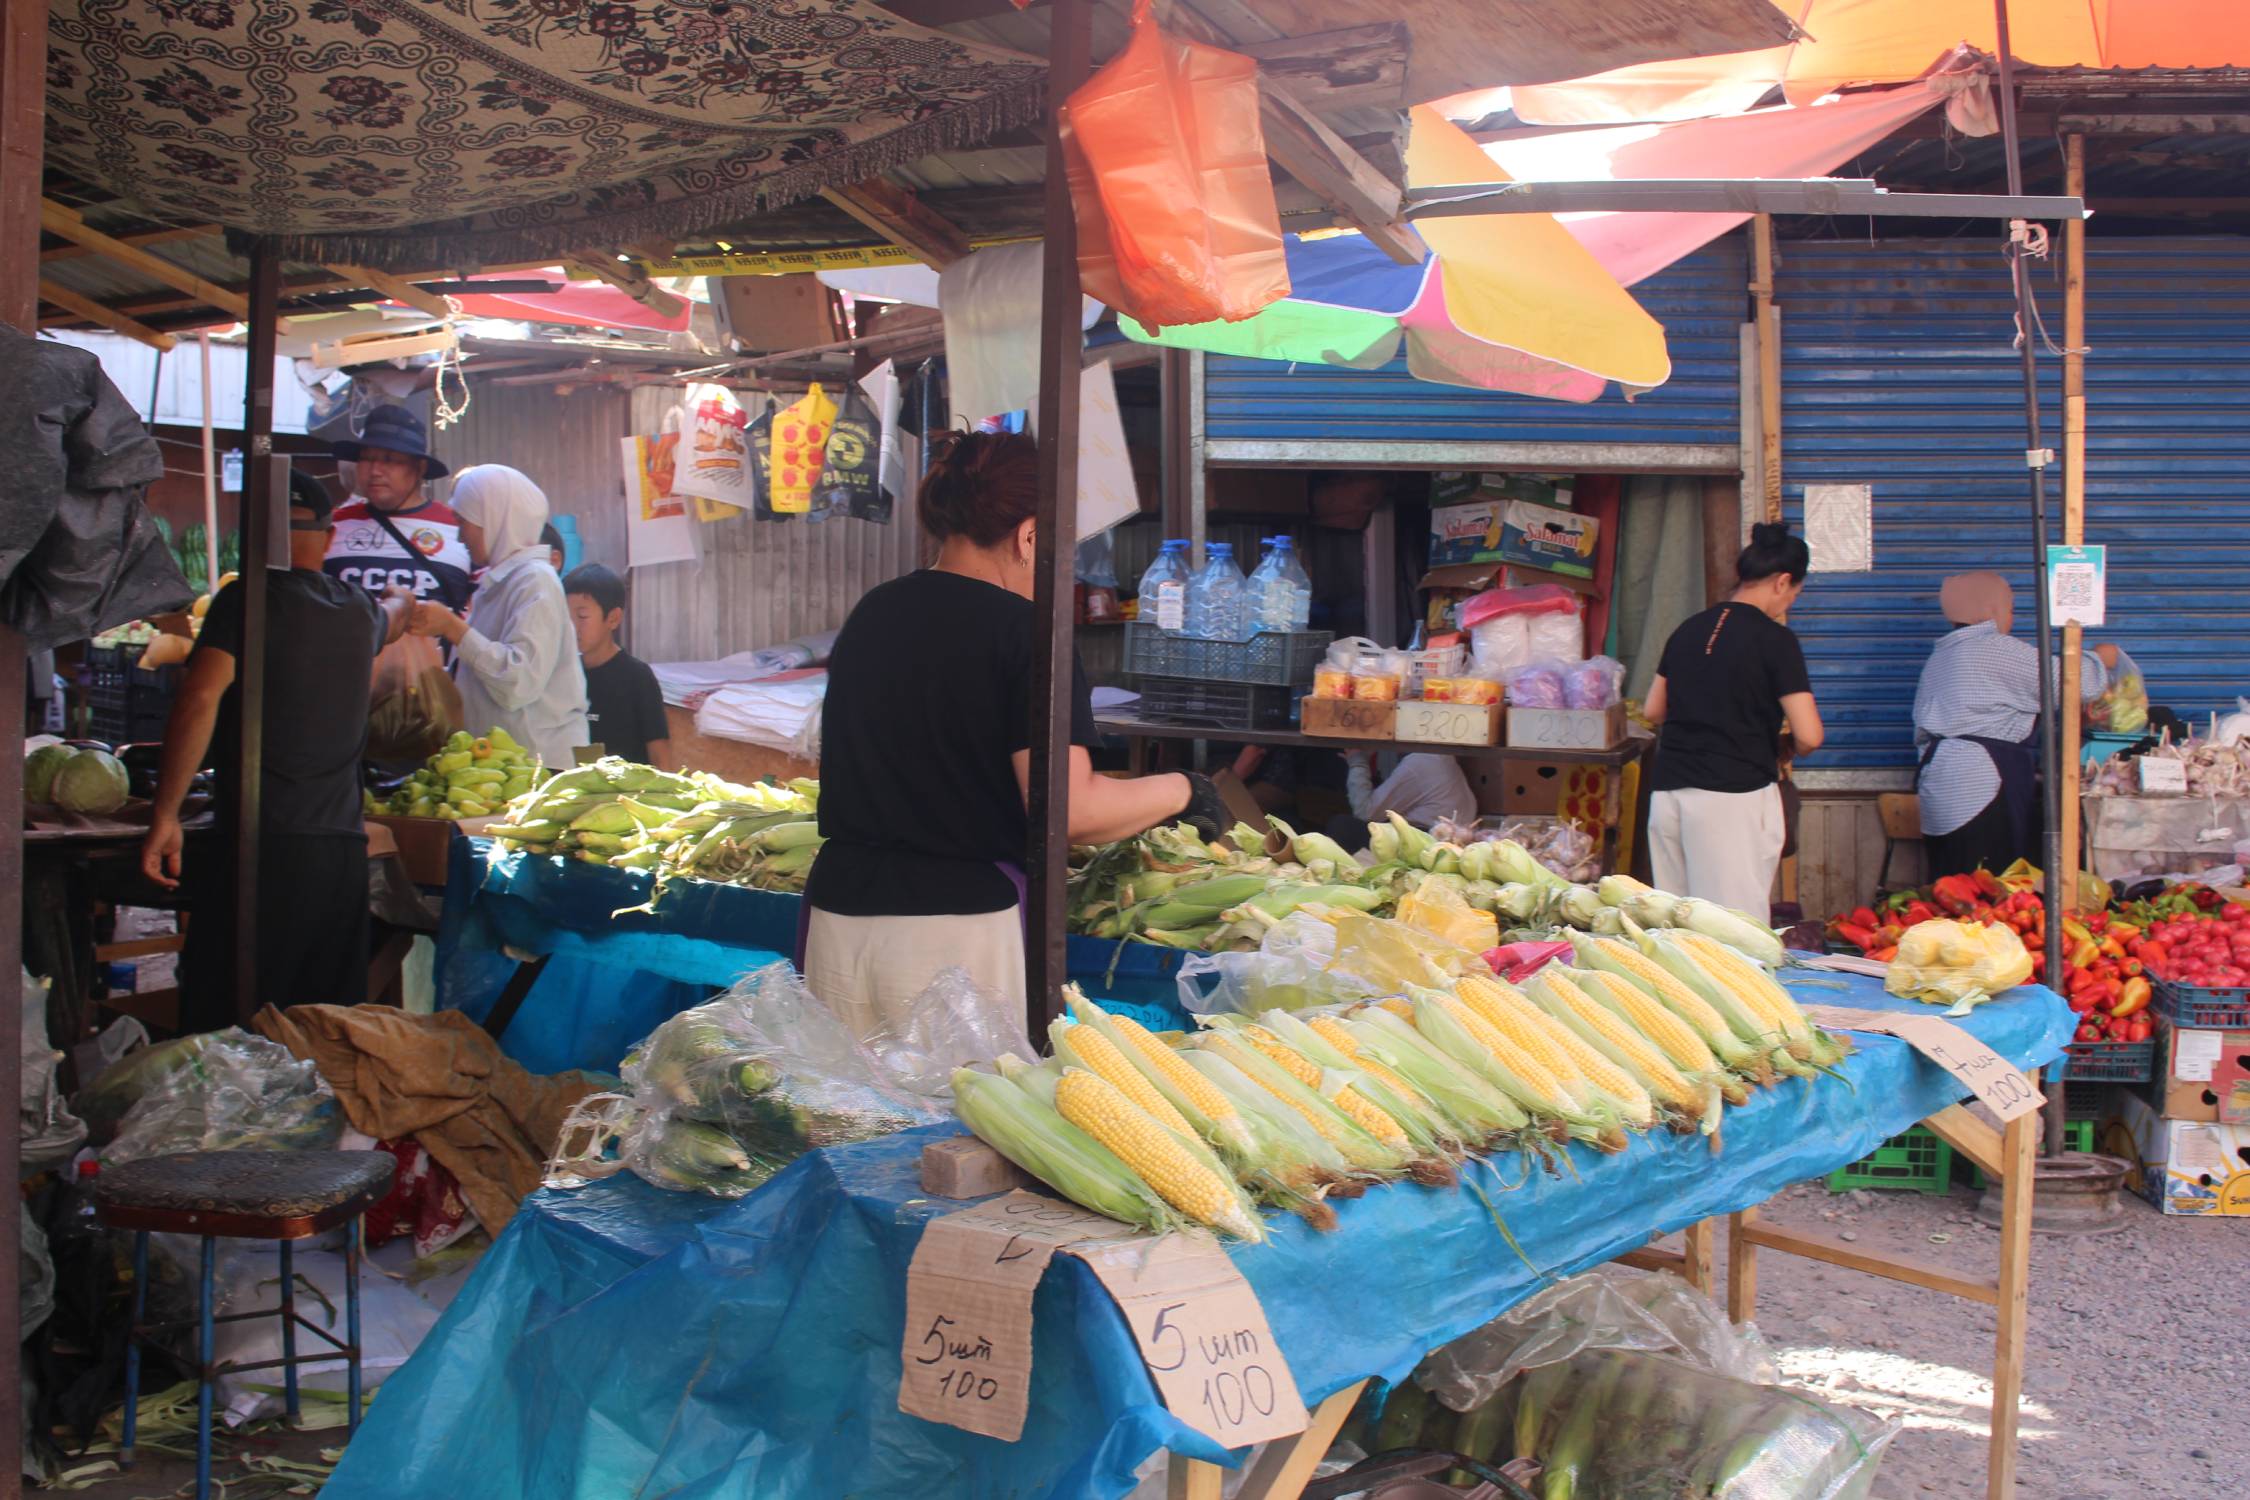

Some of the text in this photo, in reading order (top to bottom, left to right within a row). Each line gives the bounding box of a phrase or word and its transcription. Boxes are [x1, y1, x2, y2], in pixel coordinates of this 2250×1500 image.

[1413, 710, 1470, 740] 320
[1986, 1073, 2032, 1110] 100
[1148, 1303, 1187, 1371] 5
[940, 1370, 998, 1400] 100
[1203, 1365, 1274, 1429] 100
